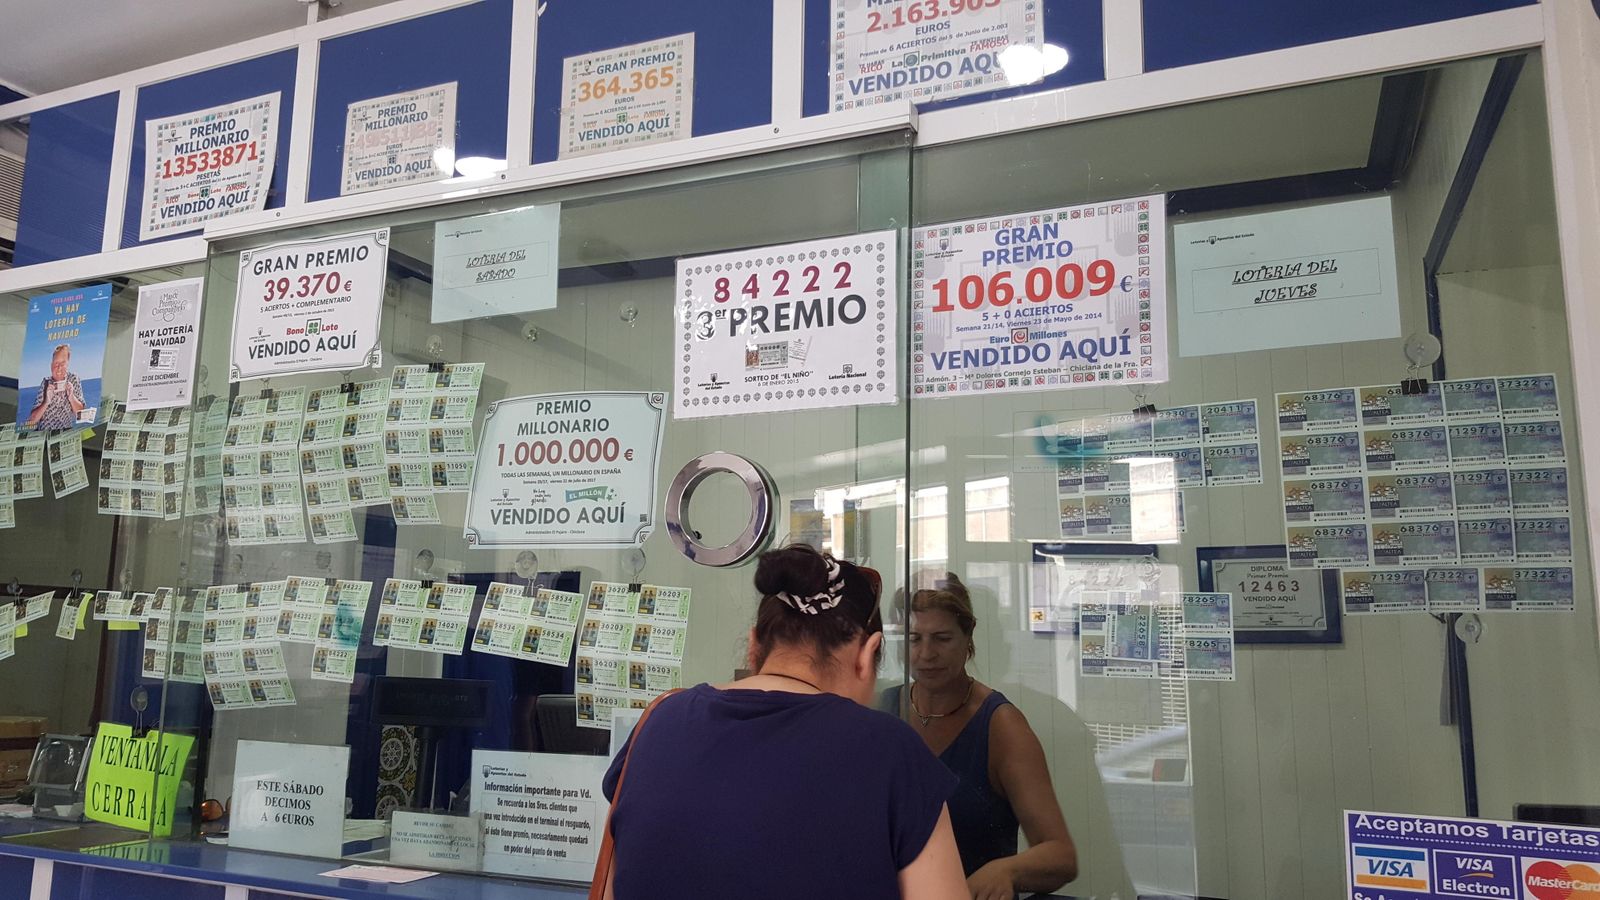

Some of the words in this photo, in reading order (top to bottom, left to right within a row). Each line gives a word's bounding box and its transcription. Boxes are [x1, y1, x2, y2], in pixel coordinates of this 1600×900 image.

[915, 20, 950, 36] EUROS
[896, 36, 937, 51] ACIERTOS
[965, 28, 981, 38] Junio
[970, 39, 1010, 53] FAMOSO
[597, 60, 627, 75] GRAN
[631, 51, 676, 68] PREMIO
[892, 60, 904, 68] La
[921, 47, 966, 63] Primitiva
[860, 62, 883, 74] RICO
[578, 66, 674, 103] 364.365
[849, 62, 952, 96] VENDIDO
[614, 96, 635, 105] EUROS
[378, 103, 417, 119] PREMIO
[190, 118, 236, 139] PREMIO
[365, 111, 428, 132] MILLONARIO
[578, 123, 634, 142] VENDIDO
[637, 114, 670, 133] AQUÍ
[174, 129, 250, 156] MILLONARIO
[196, 170, 221, 181] PESETAS
[355, 164, 402, 182] VENDIDO
[405, 156, 432, 173] AQUÍ
[161, 198, 216, 219] VENDIDO
[218, 186, 250, 208] AQUÍ
[994, 222, 1060, 247] GRAN
[253, 254, 299, 276] GRAN
[305, 245, 369, 269] PREMIO
[466, 252, 507, 269] LOTERIA
[509, 249, 526, 261] DEL
[982, 240, 1073, 267] PREMIO
[475, 268, 516, 284] SABADO
[1232, 262, 1303, 286] LOTERIA
[1307, 258, 1338, 274] DEL
[263, 271, 341, 302] 39.370
[343, 280, 353, 292] €
[932, 259, 1116, 313] 106.009
[1119, 275, 1133, 294] €
[1254, 283, 1318, 304] JUEVES
[54, 306, 63, 316] YA
[66, 303, 81, 314] HAY
[265, 302, 290, 312] ACIERTOS
[296, 295, 352, 309] COMPLEMENTARIO
[982, 312, 989, 321] 5
[1004, 310, 1011, 319] 0
[1014, 303, 1074, 319] ACIERTOS
[729, 294, 867, 337] PREMIO
[956, 325, 982, 333] Semana
[1006, 319, 1032, 328] Viernes
[1054, 315, 1073, 324] Mayo
[1084, 312, 1103, 320] 2014
[47, 328, 80, 341] NAVIDAD
[138, 328, 156, 339] HAY
[157, 323, 194, 337] LOTERÍA
[286, 327, 305, 335] Bono
[321, 323, 339, 332] Loto
[989, 334, 1010, 344] Euro
[1029, 330, 1068, 341] Millones
[149, 335, 186, 348] NAVIDAD
[248, 339, 311, 360] VENDIDO
[315, 330, 358, 353] AQUÍ
[931, 343, 1051, 371] VENDIDO
[1059, 328, 1131, 364] AQUÍ
[154, 372, 179, 381] DICIEMBRE
[744, 374, 769, 384] SORTEO
[770, 373, 779, 381] DE
[976, 371, 1003, 380] Dolores
[1003, 369, 1031, 379] Cornejo
[1032, 366, 1062, 375] Esteban
[1069, 363, 1101, 372] Chiclana
[1102, 362, 1112, 370] de
[1123, 361, 1139, 369] Fra.
[1304, 393, 1341, 401] 68376
[536, 399, 592, 416] PREMIO
[1207, 404, 1241, 414] 20411
[517, 417, 610, 437] MILLONARIO
[1392, 430, 1430, 439] 68376
[1307, 436, 1345, 445] 68376
[498, 437, 620, 467] 1.000.000
[624, 448, 634, 462] €
[561, 469, 593, 477] MILLONARIO
[601, 467, 621, 475] ESPAÑA
[1311, 481, 1349, 490] 68376
[490, 507, 570, 525] VENDIDO
[576, 501, 626, 525] AQUÍ
[1371, 573, 1409, 581] 71297
[1515, 570, 1556, 578] 37322
[657, 590, 681, 599] 36203
[600, 623, 624, 631] 36203
[652, 627, 676, 636] 36203
[100, 735, 180, 777] VENTANILA
[256, 780, 281, 792] ESTE
[283, 780, 324, 796] SÁBADO
[484, 781, 523, 793] Información
[524, 784, 561, 796] importante
[562, 789, 578, 799] para
[580, 788, 592, 799] Vd.
[92, 781, 166, 827] CERRAA
[265, 796, 311, 810] DECIMOS
[497, 797, 503, 806] Se
[504, 798, 524, 808] recuerda
[528, 800, 536, 809] los
[536, 800, 549, 810] Sres.
[549, 801, 568, 812] clientes
[568, 805, 578, 814] que
[260, 812, 268, 822] A
[274, 813, 280, 823] 6
[501, 812, 526, 823] introducido
[540, 816, 559, 826] terminal
[565, 819, 591, 831] resguardo,
[501, 828, 512, 837] tiene
[512, 830, 530, 841] premio,
[531, 832, 568, 843] necesariamente
[568, 835, 589, 845] quedará
[1355, 813, 1489, 839] Aceptamos
[1495, 823, 1600, 846] Tarjetas
[510, 845, 524, 854] poder
[524, 845, 532, 854] del
[532, 848, 545, 857] punto
[546, 848, 553, 857] de
[553, 849, 567, 858] venta
[1367, 858, 1414, 878] VISA
[1455, 856, 1495, 872] VISA
[1442, 878, 1511, 896] Electron
